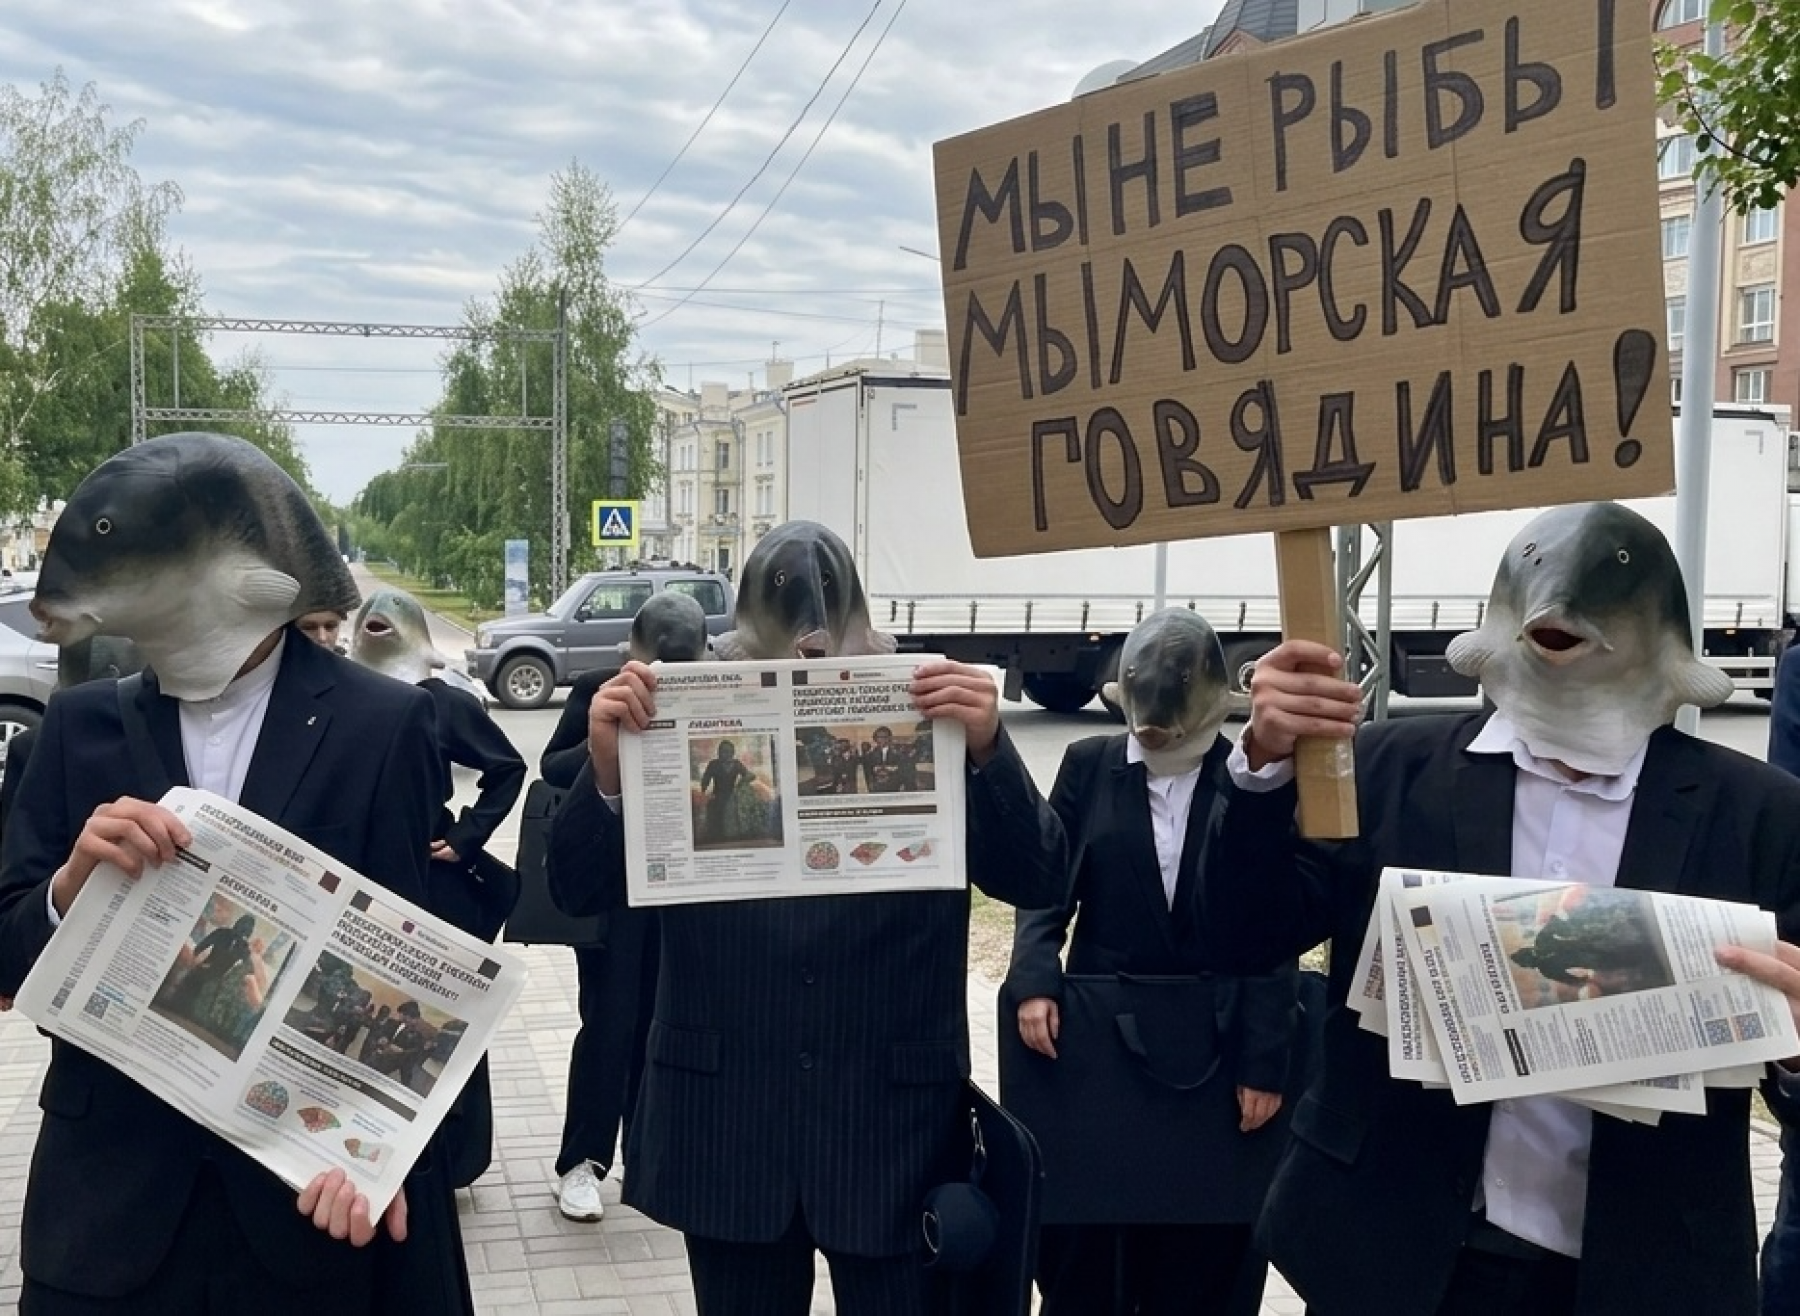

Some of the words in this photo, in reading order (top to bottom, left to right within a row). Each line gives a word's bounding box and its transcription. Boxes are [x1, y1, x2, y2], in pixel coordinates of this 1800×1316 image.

[953, 134, 1090, 271] МЫ
[1108, 91, 1232, 236] НЕ
[1265, 0, 1616, 192] РЫБЫ
[957, 261, 1102, 417] МЫ
[1110, 156, 1586, 385] МОРСКАЯ
[1032, 328, 1658, 532] ГОВЯДИНА!
